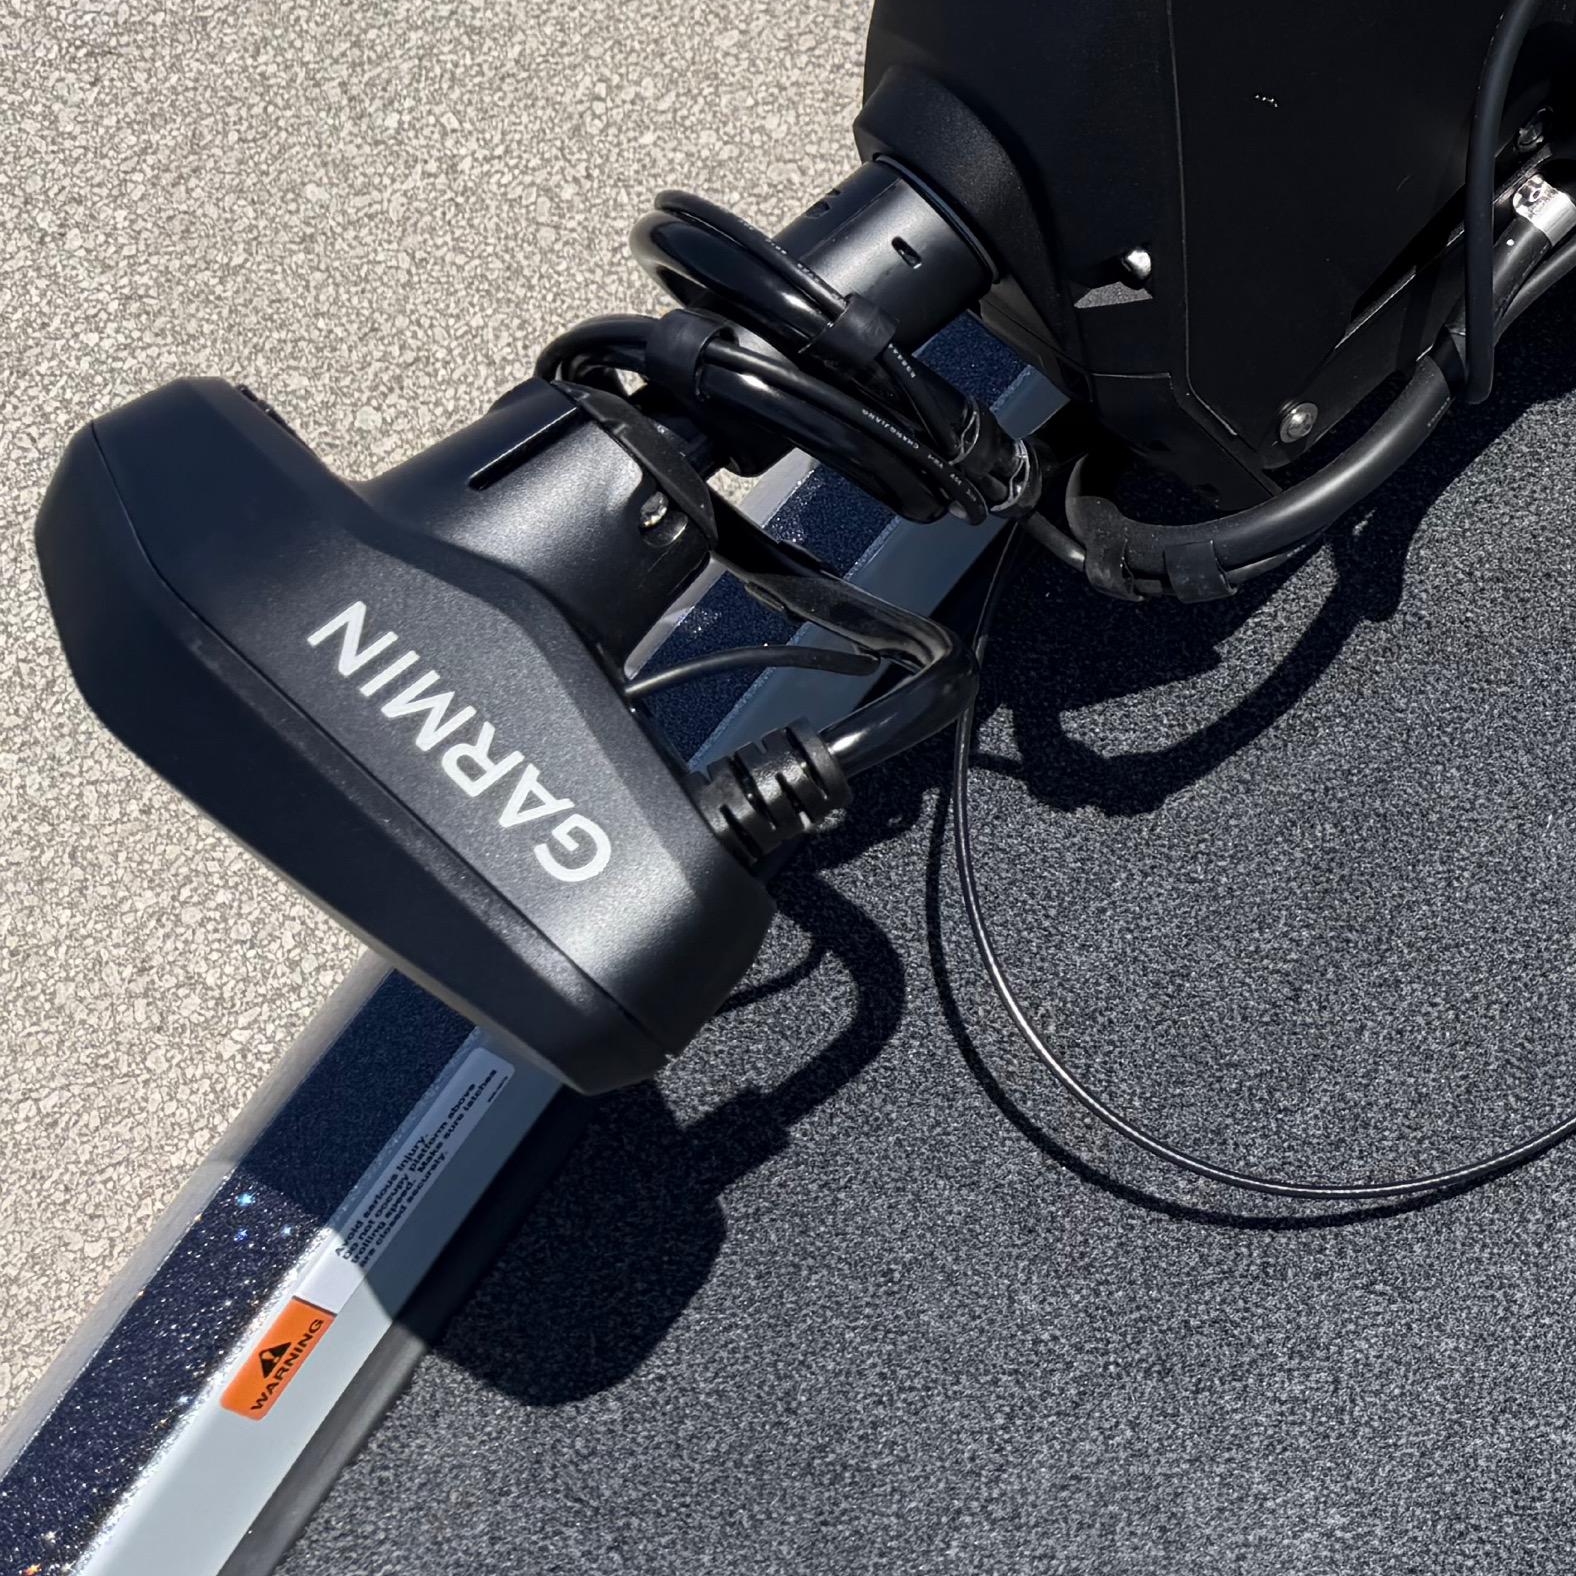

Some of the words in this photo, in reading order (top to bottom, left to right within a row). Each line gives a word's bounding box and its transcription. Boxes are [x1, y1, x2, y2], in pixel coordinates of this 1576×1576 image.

[307, 600, 612, 883] GARMIN
[336, 1219, 363, 1256] Avoid
[363, 1174, 399, 1218] serious
[352, 1223, 386, 1264] trolling
[417, 1140, 443, 1172] Make
[443, 1114, 464, 1139] sure
[465, 1069, 497, 1112] latches
[359, 1219, 376, 1240] not
[375, 1174, 409, 1218] occupy
[410, 1121, 449, 1172] platform
[448, 1083, 476, 1120] above
[359, 1248, 376, 1267] are
[375, 1205, 406, 1245] closed
[249, 1317, 324, 1412] WARNING
